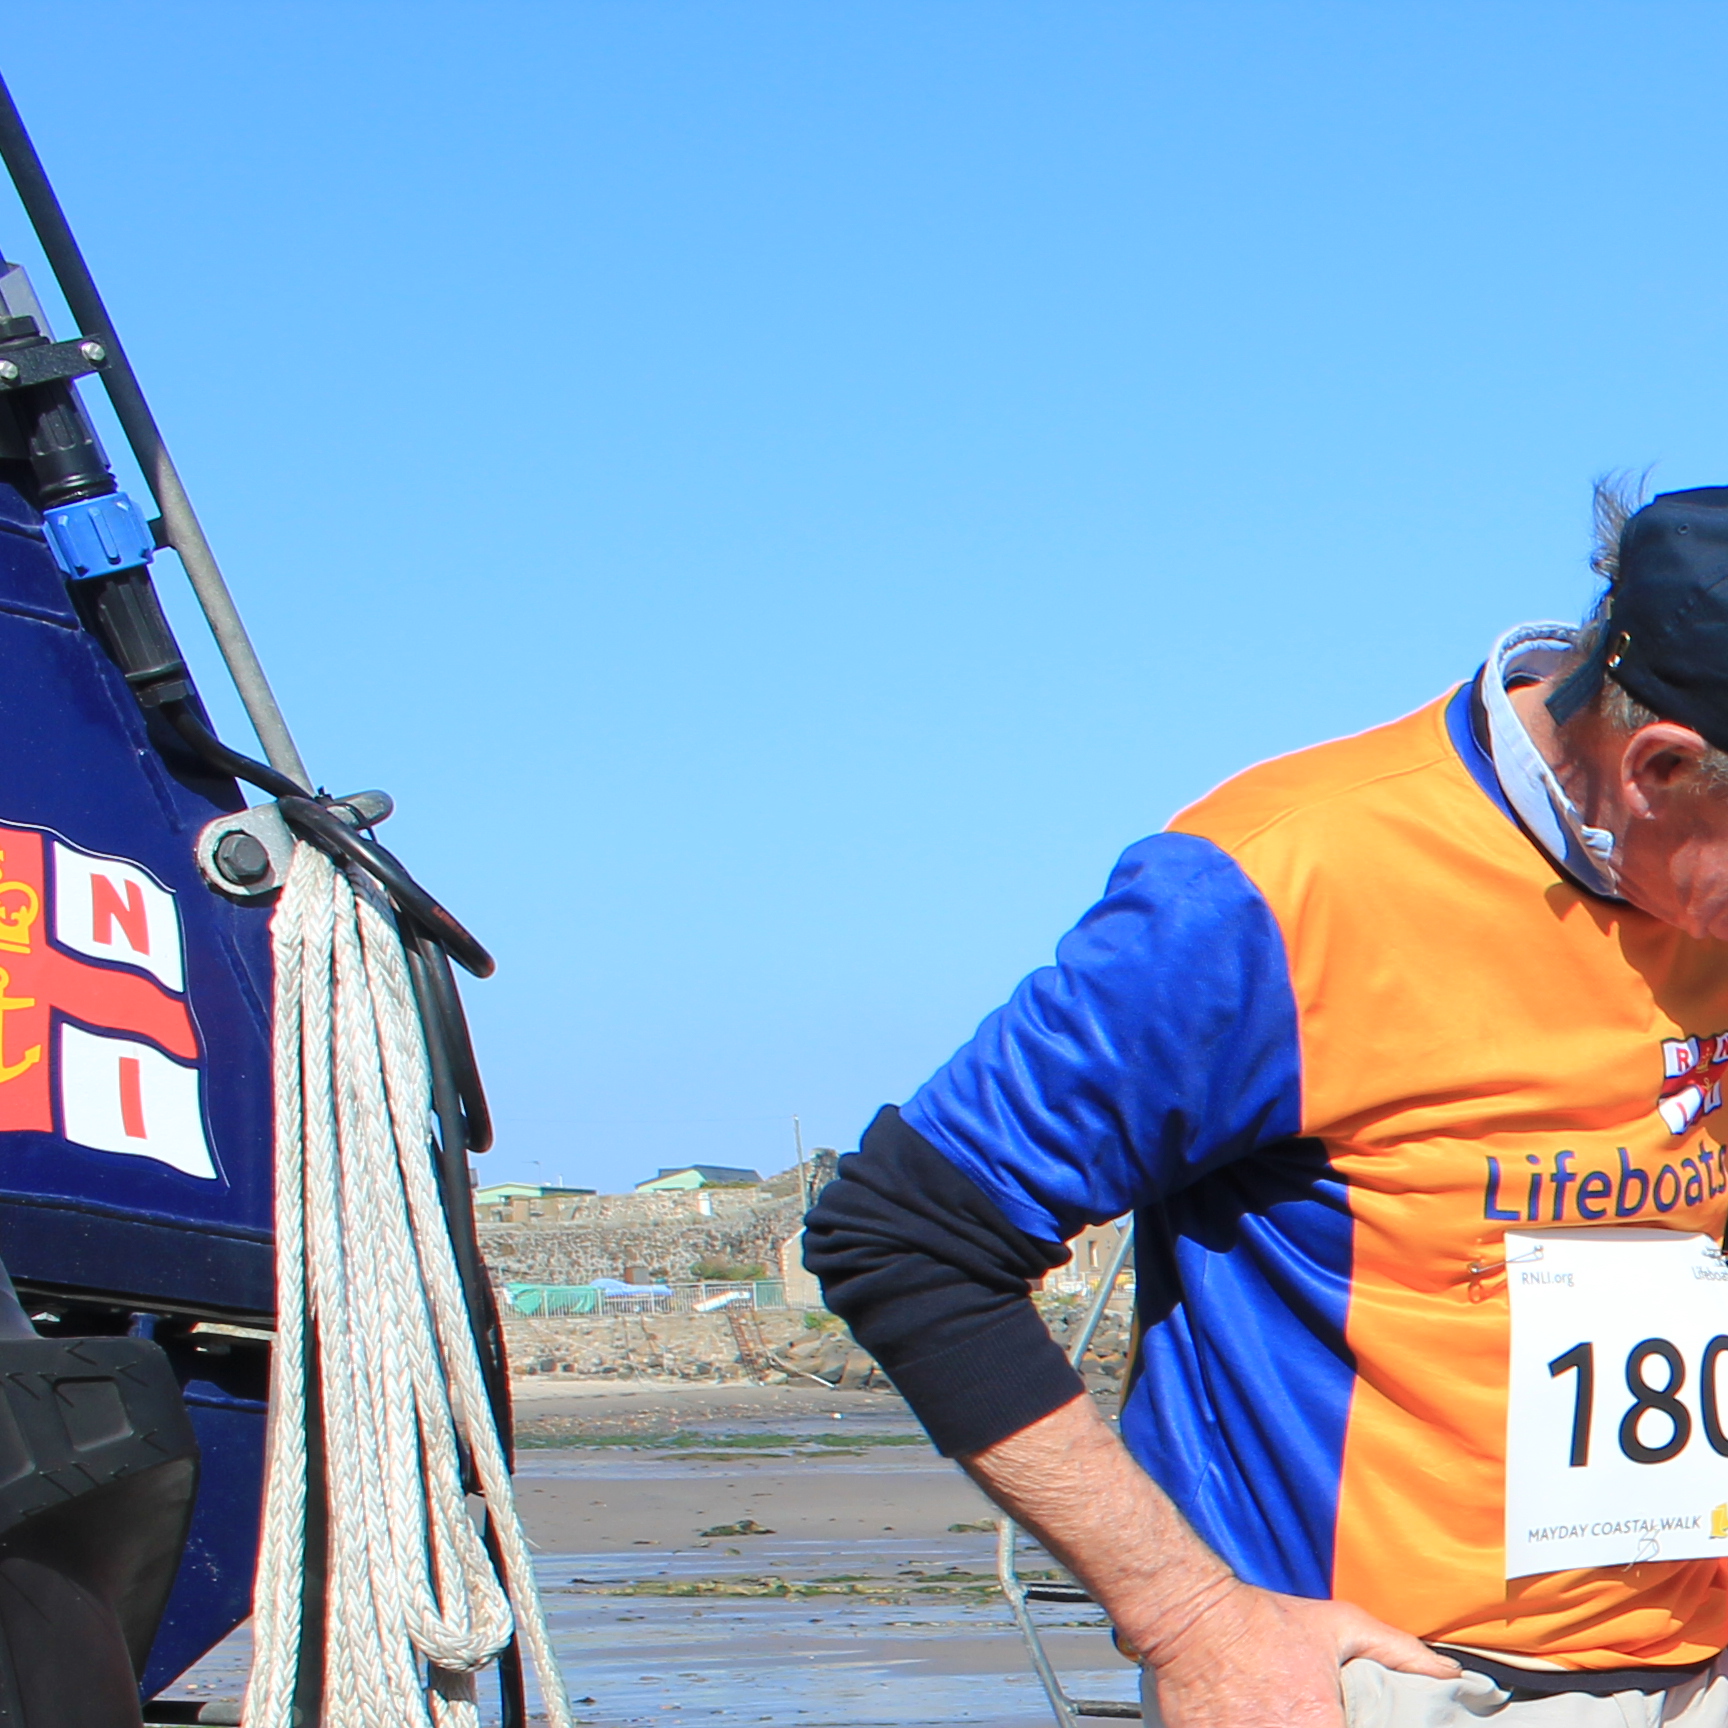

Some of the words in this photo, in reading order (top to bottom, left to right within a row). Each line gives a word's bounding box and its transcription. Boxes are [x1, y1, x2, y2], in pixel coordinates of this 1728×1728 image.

[90, 873, 150, 956] N
[1676, 1047, 1691, 1073] R
[118, 1056, 148, 1140] I
[1484, 1140, 1727, 1222] Lifeboats
[1521, 1272, 1575, 1288] RNLI.org
[1528, 1523, 1590, 1543] MAYDAY
[1591, 1517, 1657, 1537] COASTAL
[1659, 1515, 1702, 1532] WALK
